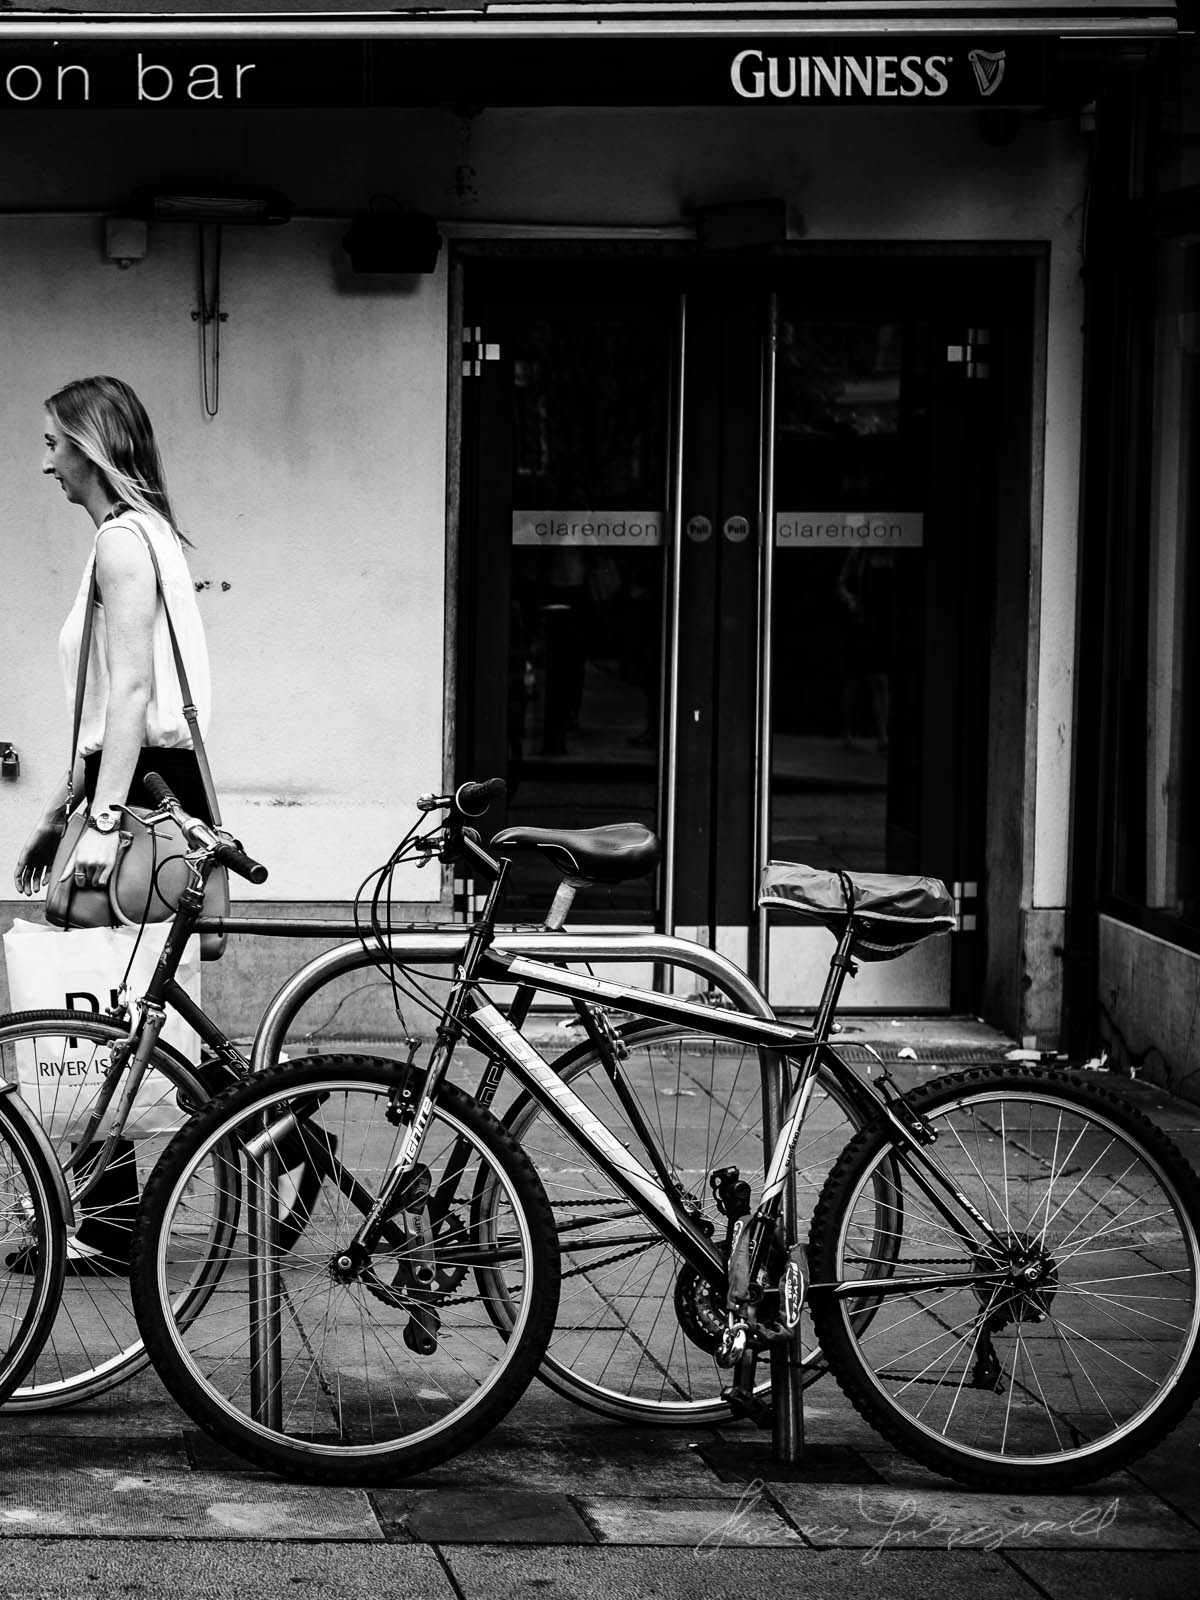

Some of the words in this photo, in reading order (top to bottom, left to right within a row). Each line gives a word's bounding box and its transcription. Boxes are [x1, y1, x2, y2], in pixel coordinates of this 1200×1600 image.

[137, 52, 256, 101] bar
[730, 49, 949, 98] GUINNESS
[535, 520, 658, 537] clarendon
[727, 523, 746, 534] Pull
[779, 521, 902, 538] clarendon
[39, 1060, 88, 1077] RIVER
